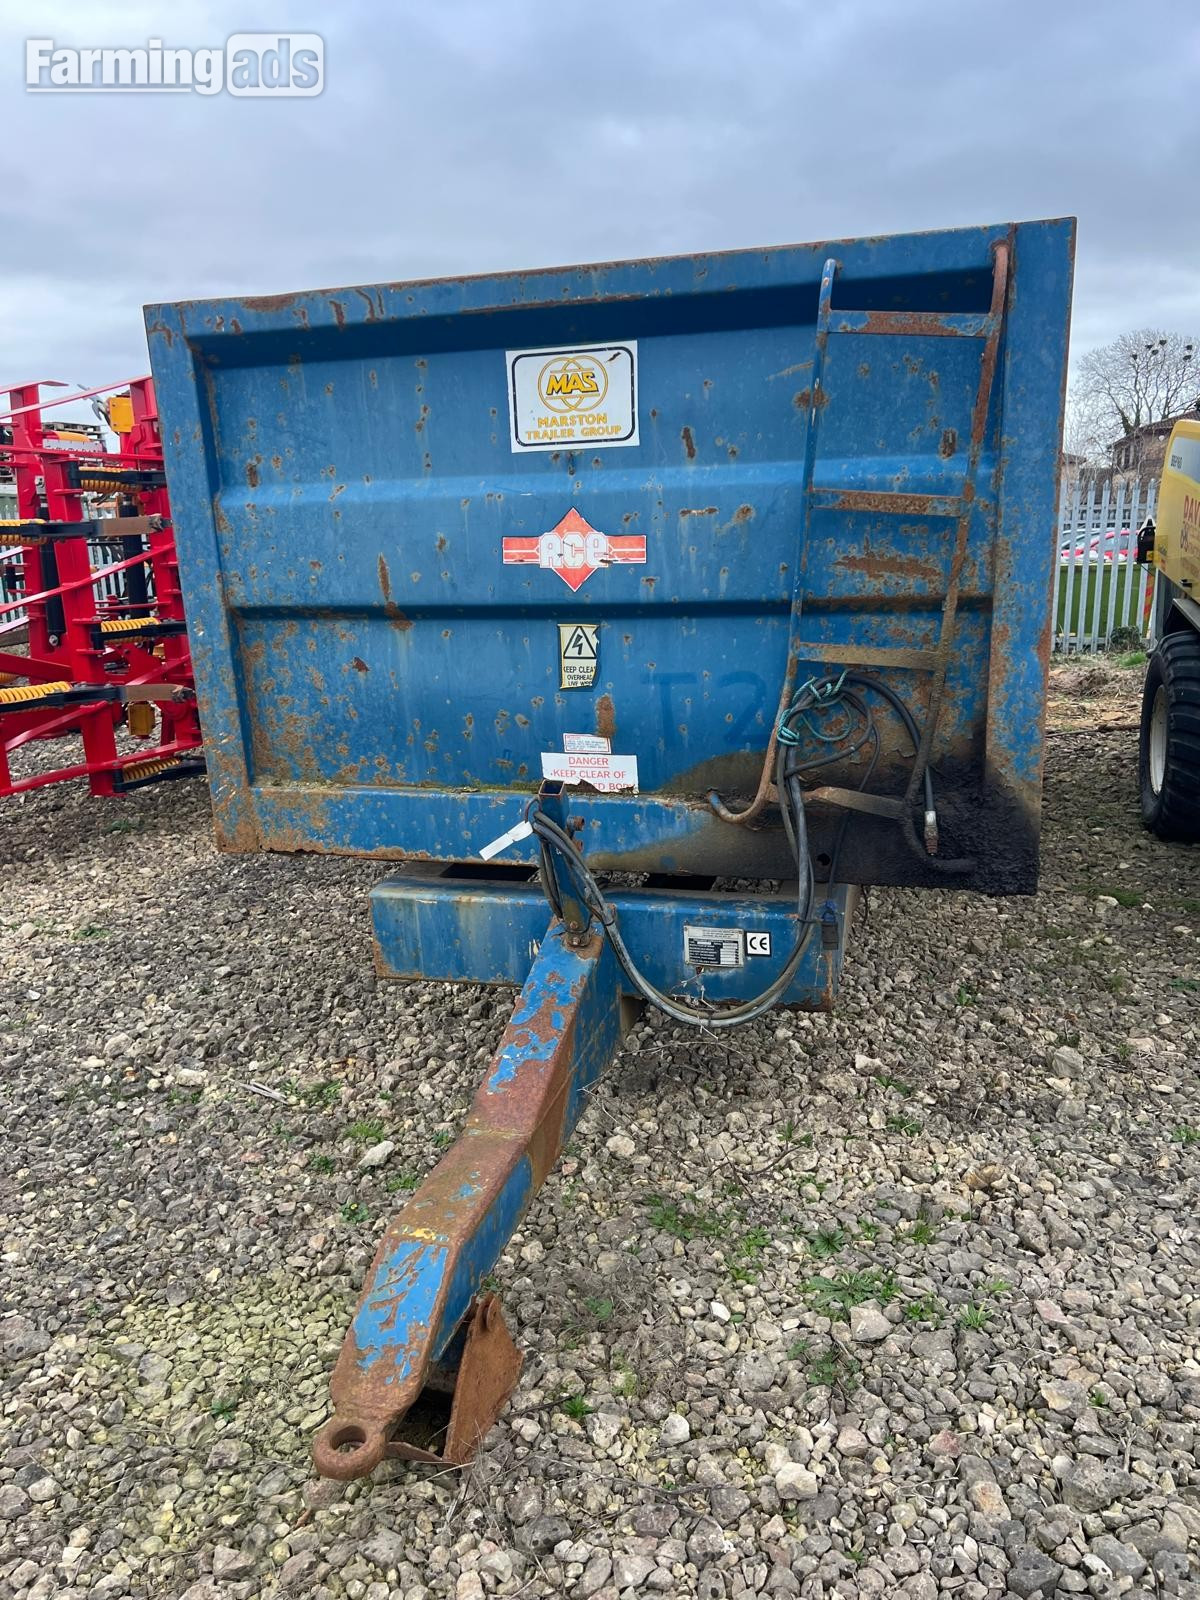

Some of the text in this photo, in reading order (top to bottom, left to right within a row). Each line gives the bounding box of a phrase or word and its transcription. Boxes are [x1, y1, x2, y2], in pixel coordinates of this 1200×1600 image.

[546, 371, 600, 396] MAS
[537, 412, 608, 429] MARSTON
[525, 425, 622, 441] TRAILER GROUP
[578, 666, 597, 674] CLEA
[568, 756, 609, 766] DANGER
[553, 768, 627, 779] KEEP CLEAR OF
[749, 936, 768, 951] CE
